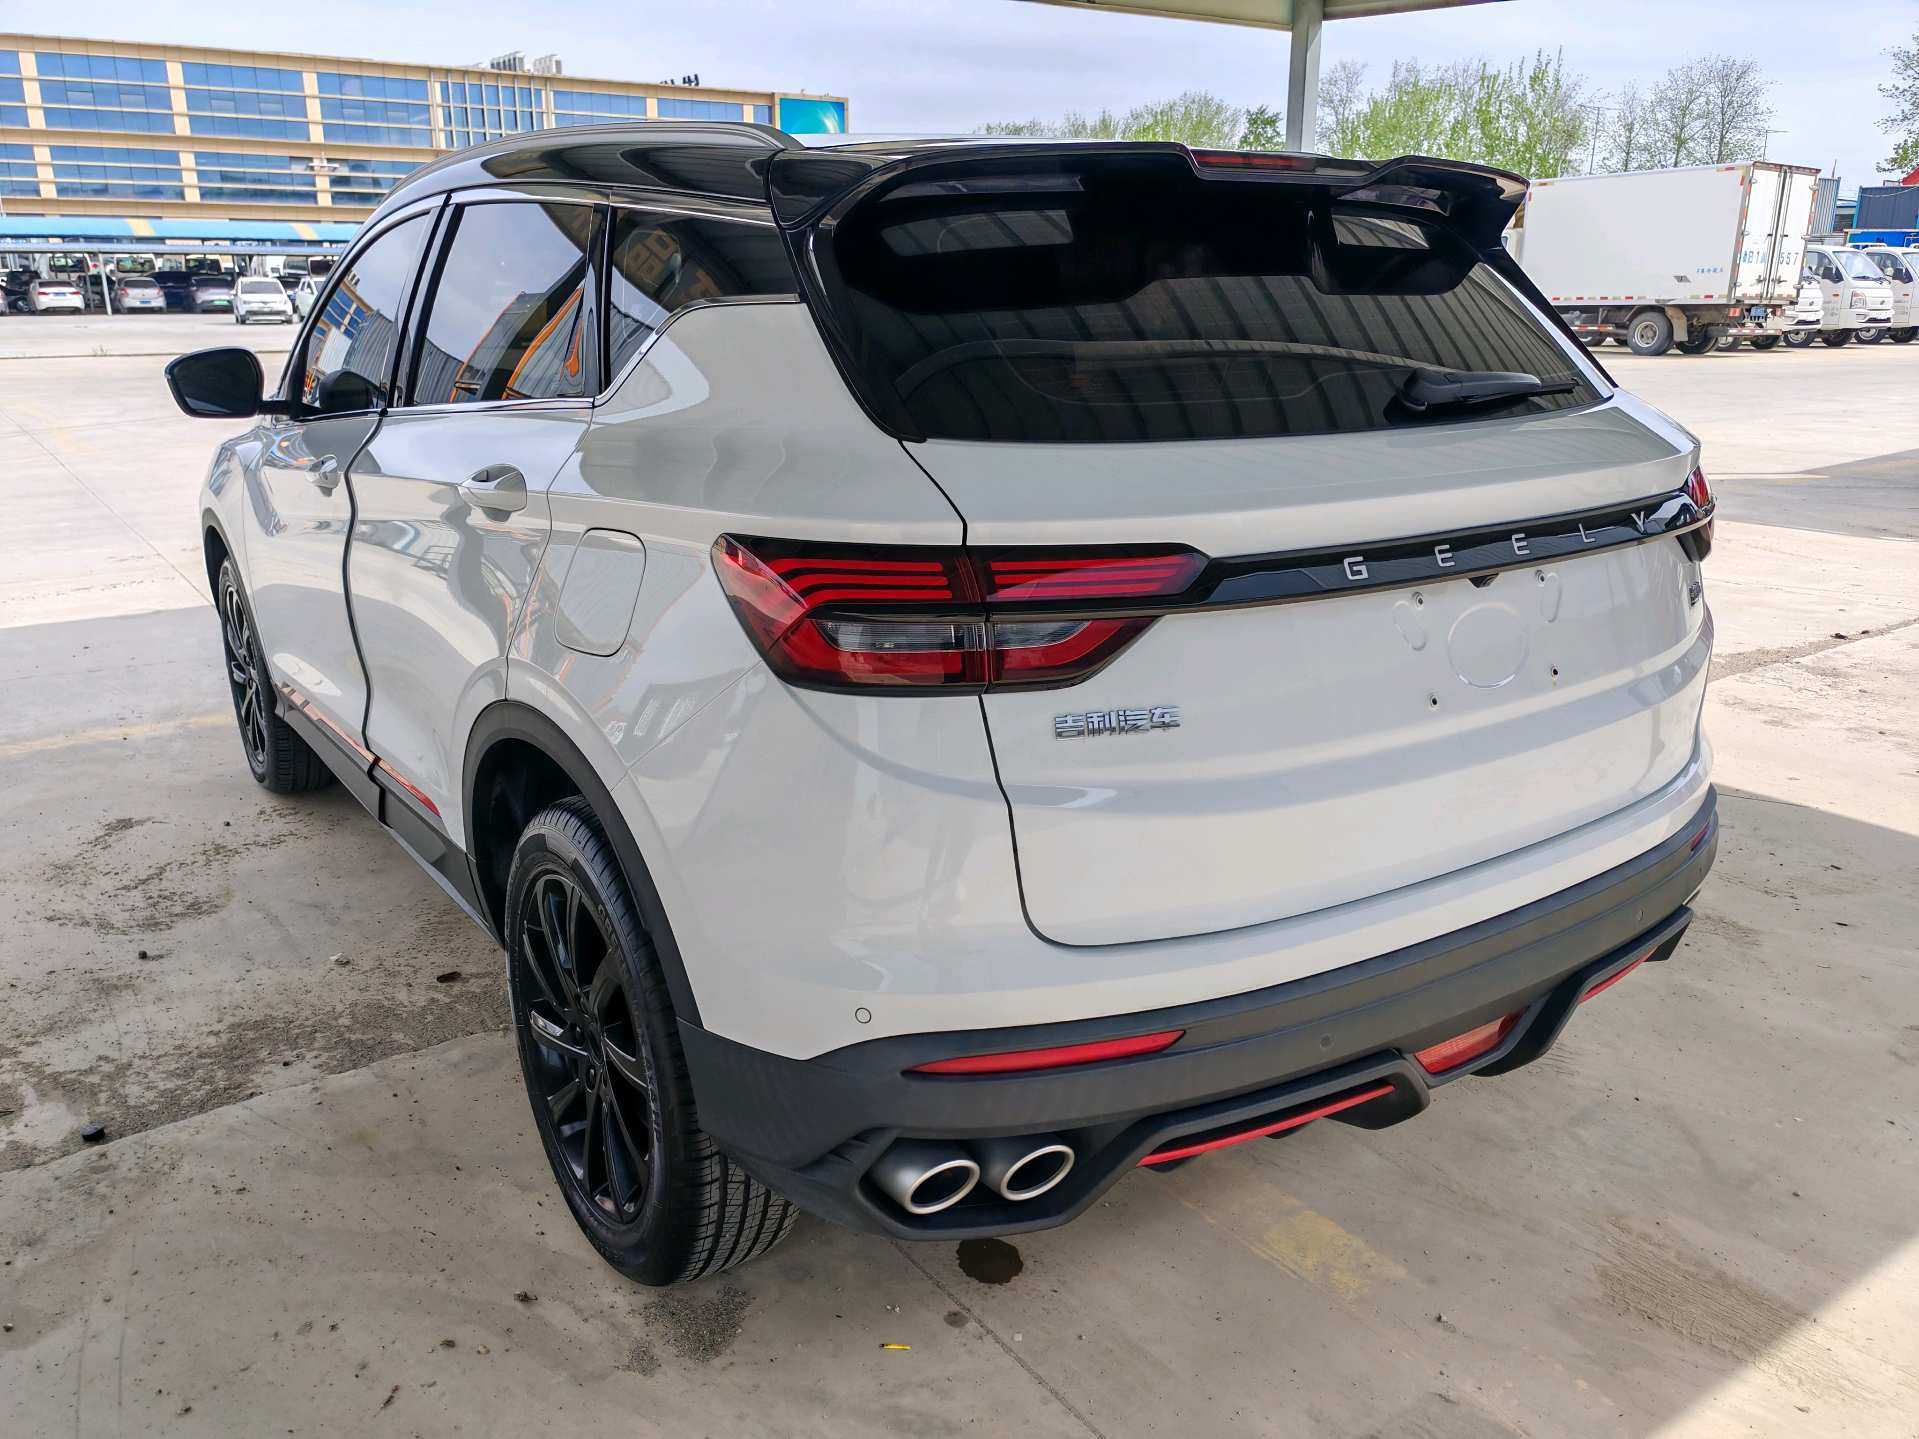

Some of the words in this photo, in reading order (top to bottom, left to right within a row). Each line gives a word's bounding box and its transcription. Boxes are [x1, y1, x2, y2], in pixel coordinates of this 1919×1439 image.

[1343, 511, 1648, 581] GEELY
[1054, 705, 1182, 742] 吉利汽车
